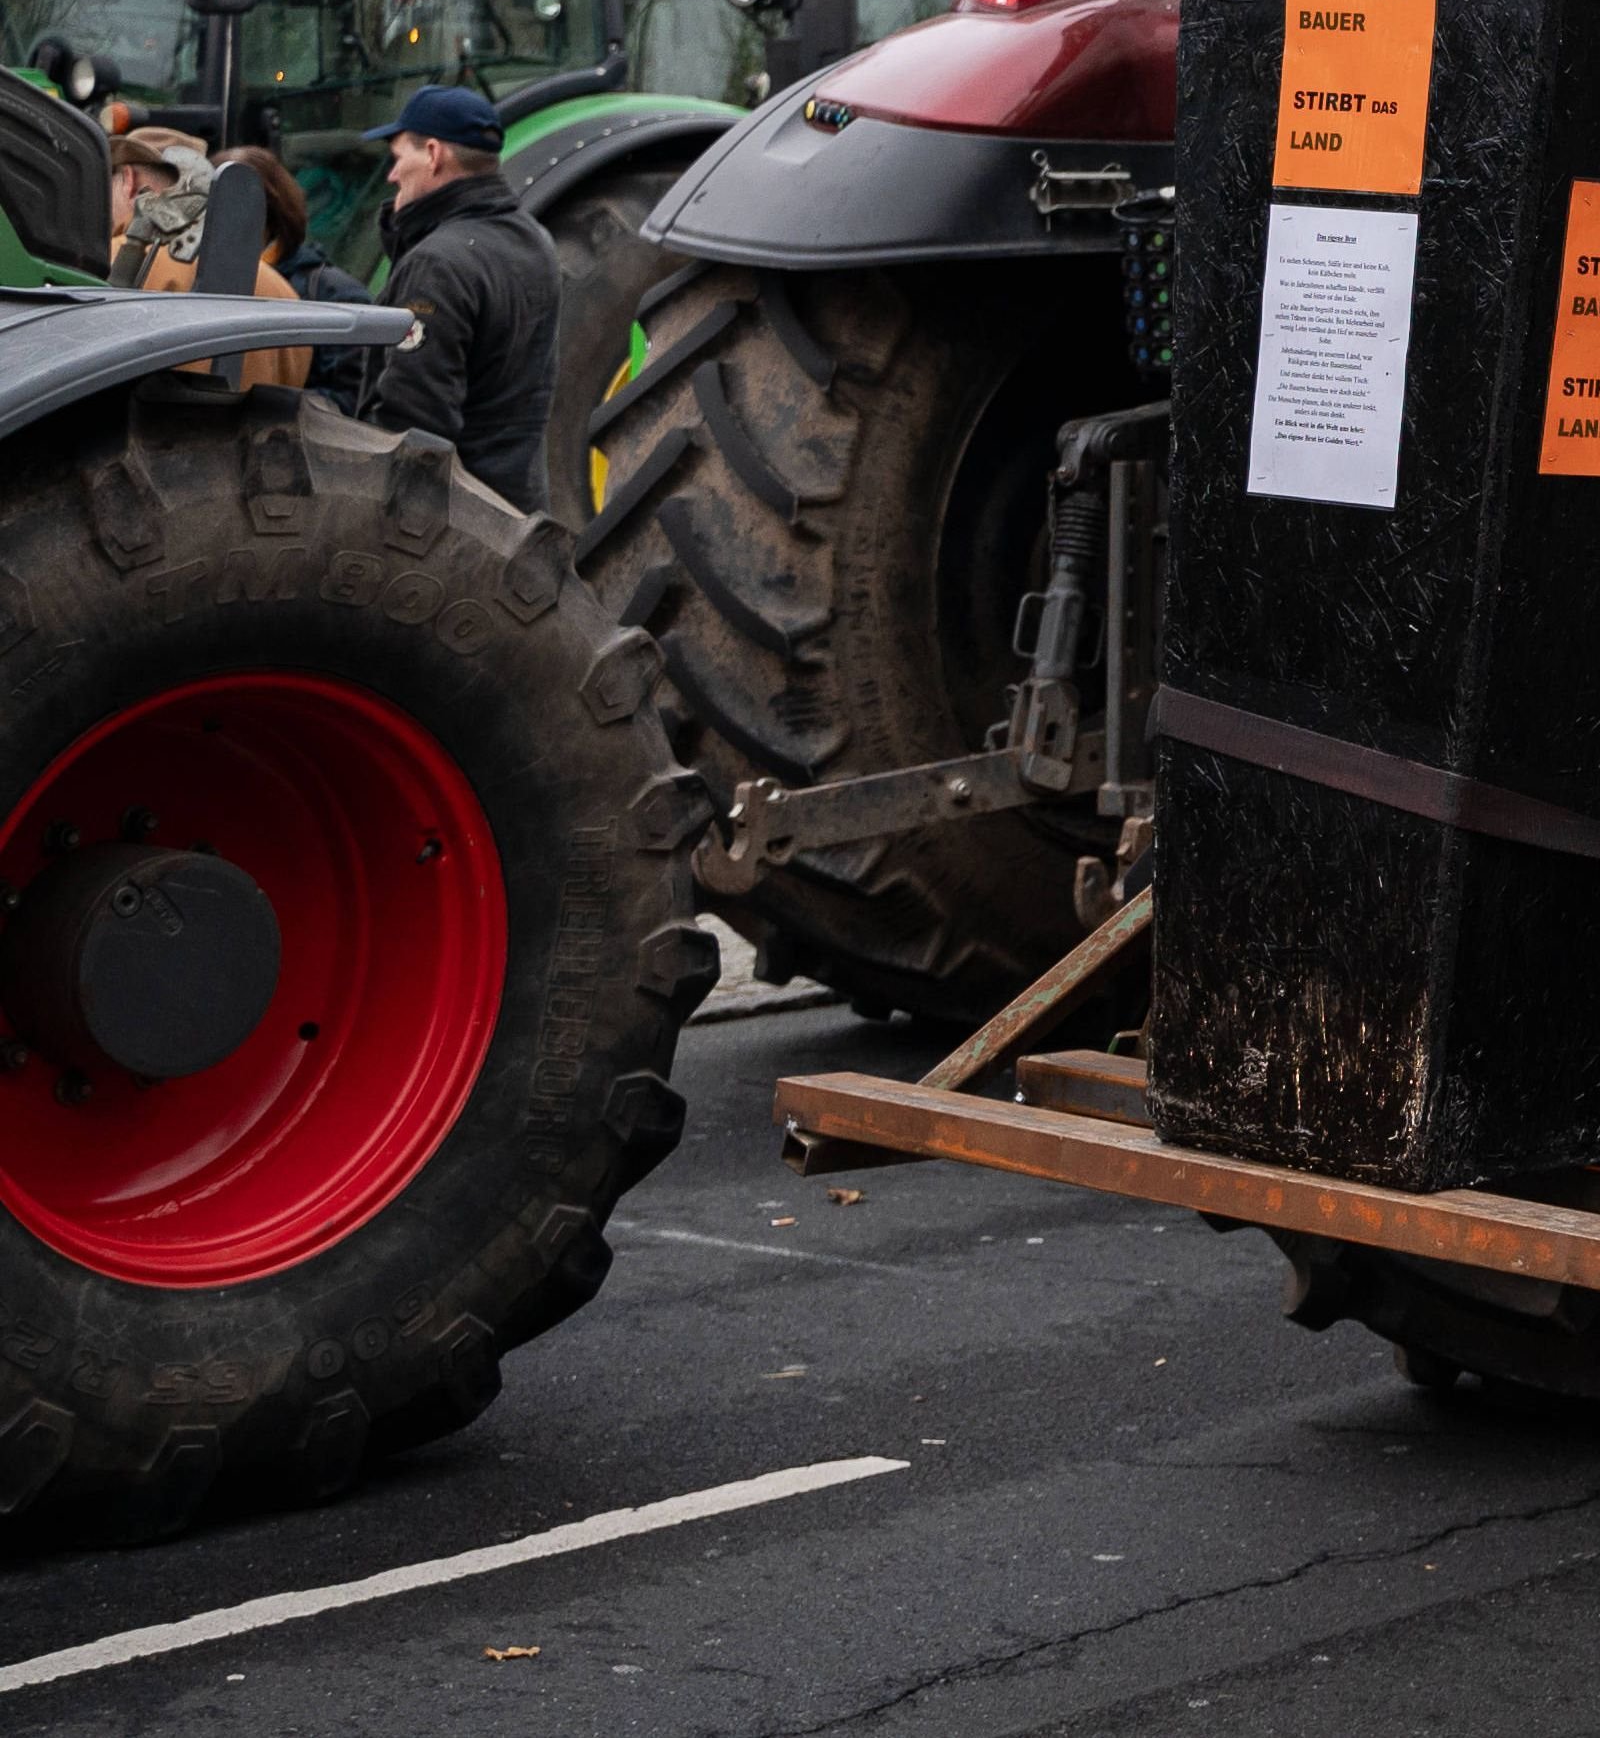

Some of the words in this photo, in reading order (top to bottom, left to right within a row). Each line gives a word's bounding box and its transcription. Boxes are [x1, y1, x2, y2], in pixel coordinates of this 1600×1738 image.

[1299, 10, 1366, 32] BAUER
[1293, 90, 1367, 113] STIRBT
[1371, 100, 1398, 115] DAS
[1290, 131, 1343, 152] LAND
